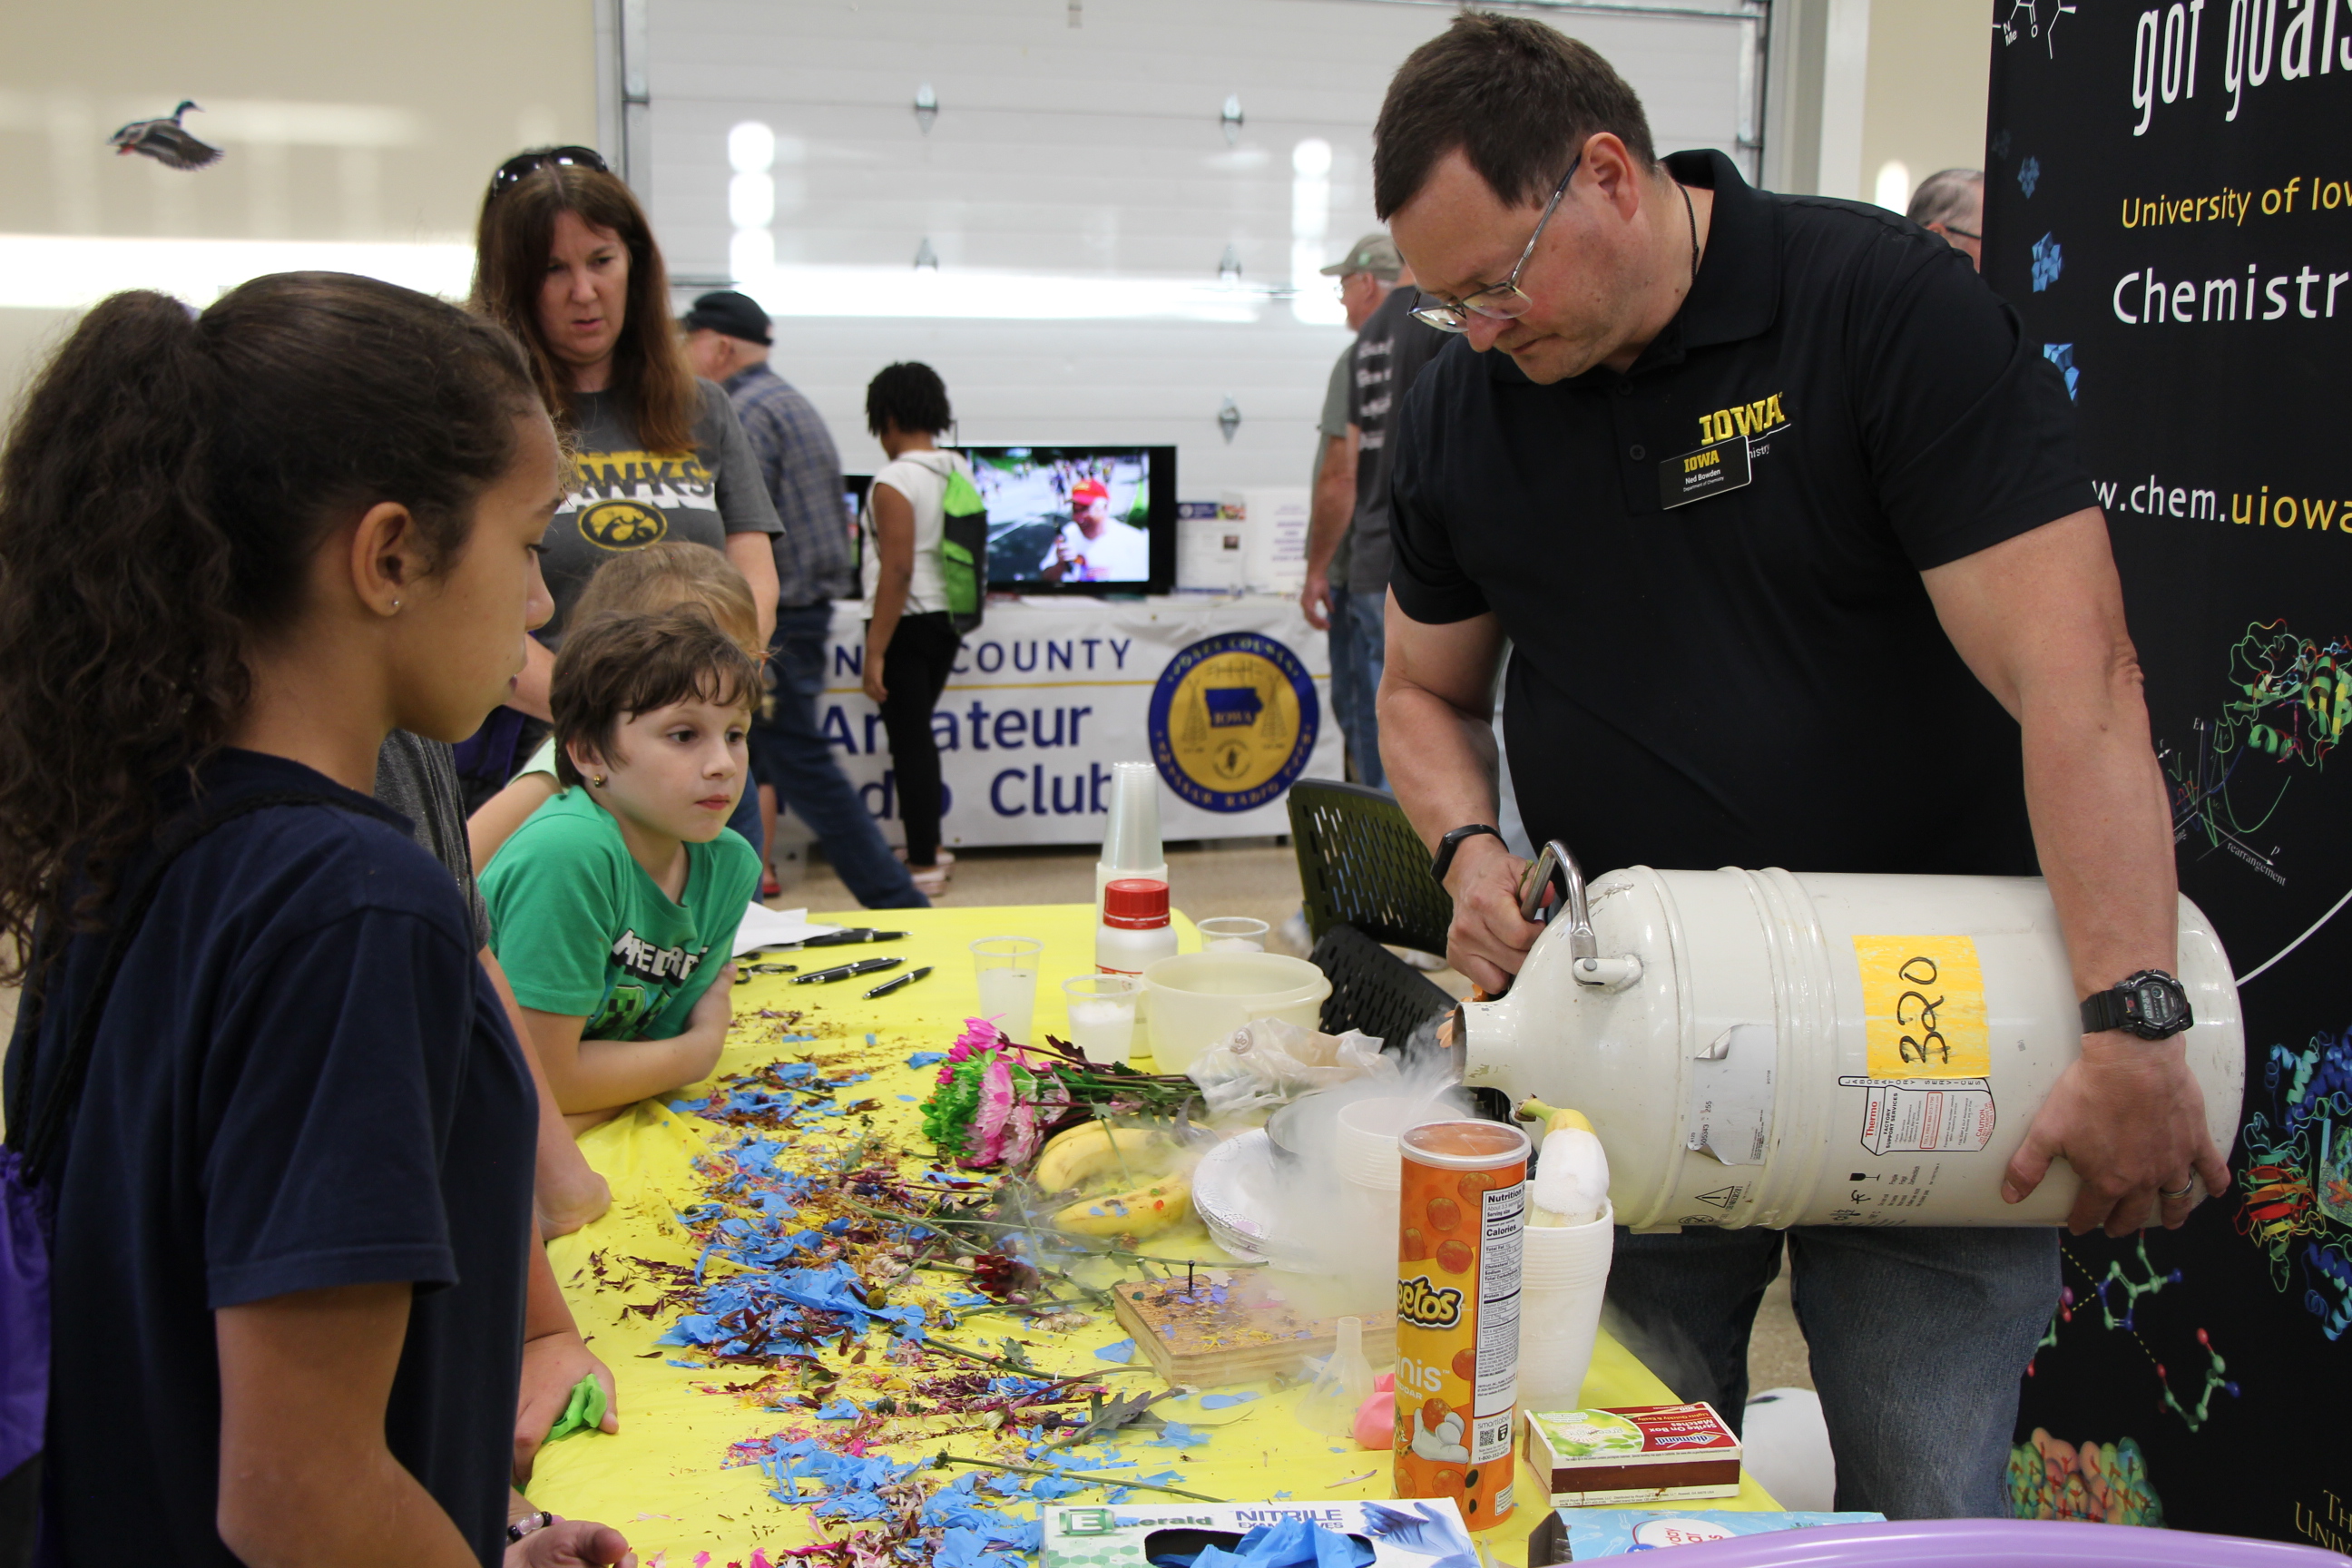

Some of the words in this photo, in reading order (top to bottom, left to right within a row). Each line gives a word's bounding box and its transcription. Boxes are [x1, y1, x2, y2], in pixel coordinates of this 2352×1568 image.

[2132, 0, 2205, 136] got
[2122, 187, 2251, 229] University
[2261, 177, 2300, 215] of
[2113, 264, 2348, 324] Chemistr
[1699, 393, 1785, 445] IOWA
[1683, 450, 1720, 473] IOWA
[1683, 483, 1703, 492] Department
[1707, 476, 1724, 485] Chemistry
[1685, 475, 1697, 485] Ned
[1698, 469, 1720, 481] Bowden
[2227, 841, 2287, 887] rearrangement
[1865, 1102, 1877, 1137] Thermo
[1976, 1110, 1984, 1137] CAUTION
[1886, 1123, 1894, 1148] SUPPORT
[1488, 1188, 1521, 1203] Nutrition
[1487, 1224, 1516, 1236] Calories
[1688, 1422, 1718, 1431] Strike
[1655, 1436, 1708, 1445] diamond
